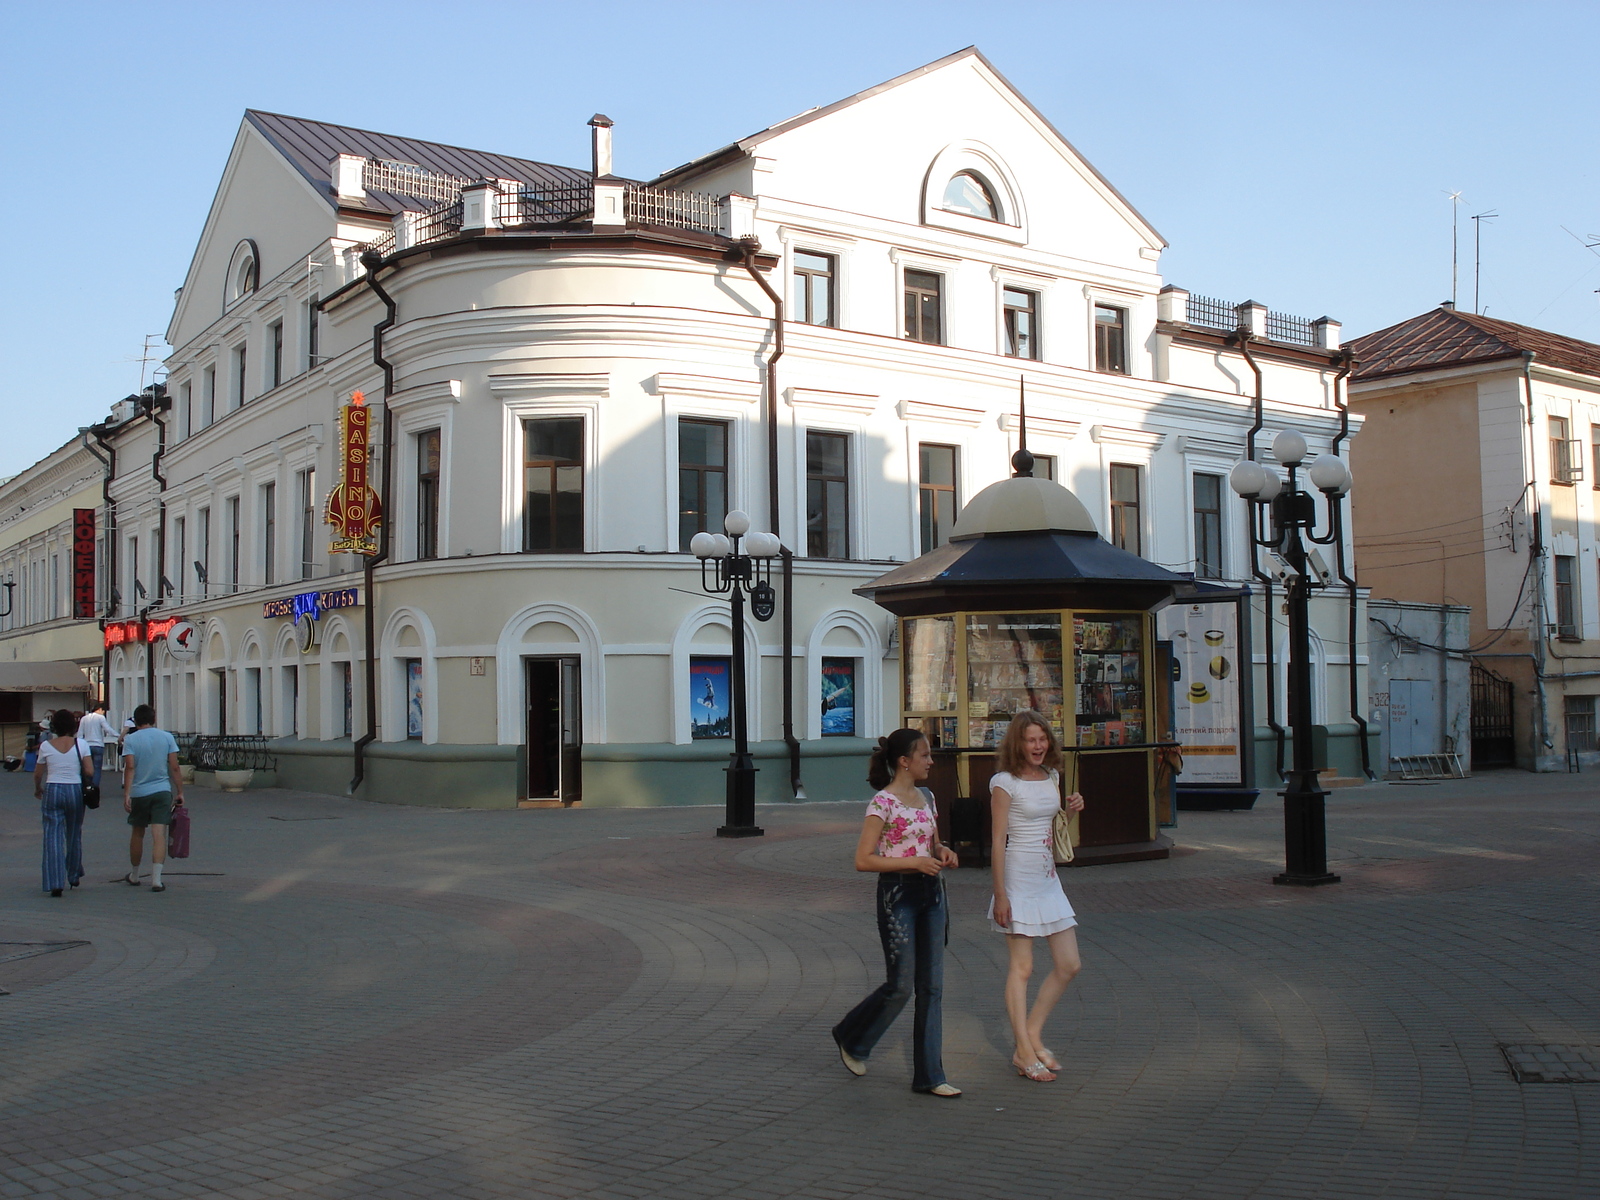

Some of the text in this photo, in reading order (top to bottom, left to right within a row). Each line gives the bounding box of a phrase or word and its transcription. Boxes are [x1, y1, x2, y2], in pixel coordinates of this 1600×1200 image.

[347, 410, 366, 521] CASINO
[75, 510, 95, 618] КОФЕЙНЯ
[1180, 726, 1207, 734] летний
[1208, 726, 1237, 735] подарок
